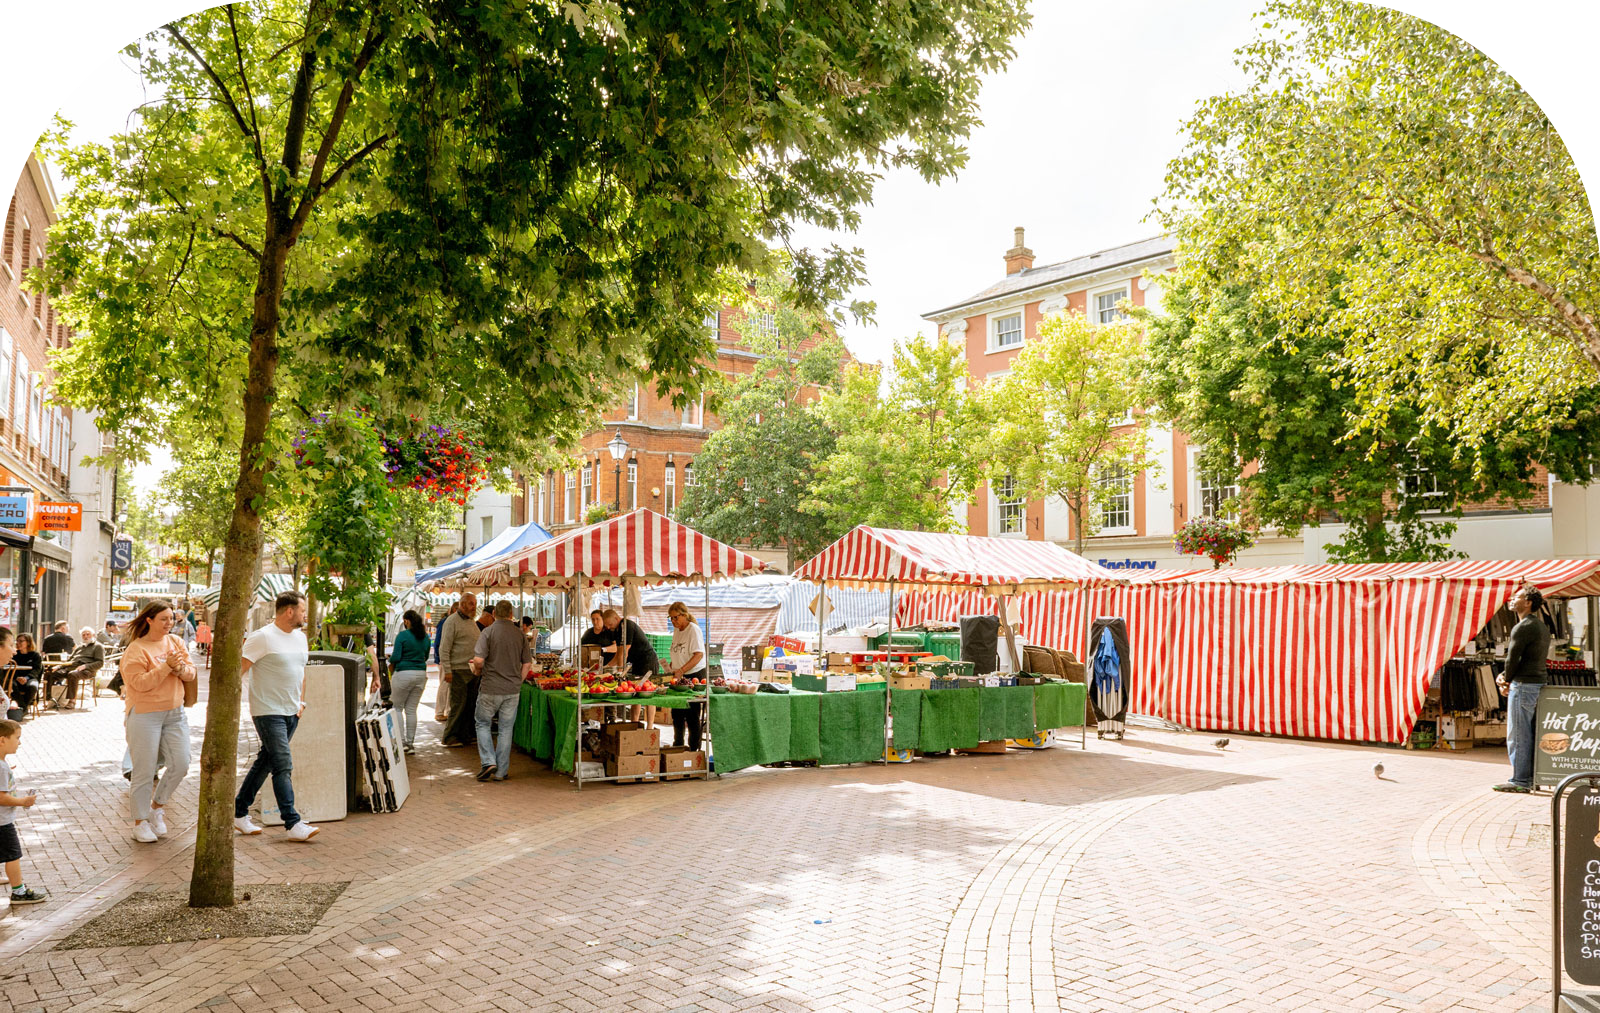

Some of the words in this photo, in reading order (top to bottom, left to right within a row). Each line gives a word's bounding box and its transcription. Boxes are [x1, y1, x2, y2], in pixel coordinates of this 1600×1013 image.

[114, 548, 130, 569] S
[1542, 712, 1574, 731] Hot
[1574, 713, 1600, 731] Por
[1570, 757, 1600, 765] STUFFIN
[1582, 898, 1600, 909] Tu
[1582, 921, 1600, 932] Co
[1580, 932, 1600, 945] Pi
